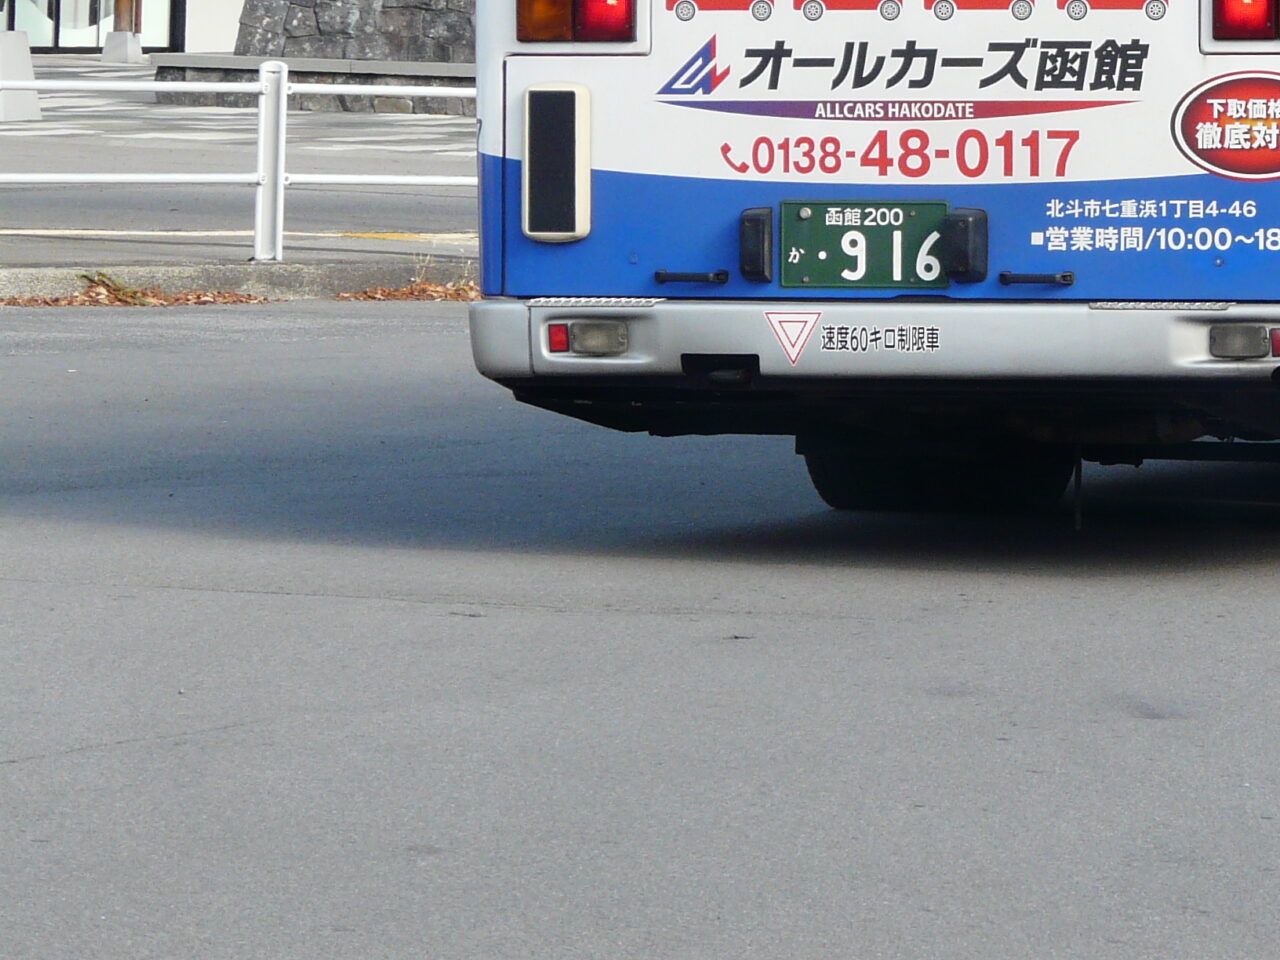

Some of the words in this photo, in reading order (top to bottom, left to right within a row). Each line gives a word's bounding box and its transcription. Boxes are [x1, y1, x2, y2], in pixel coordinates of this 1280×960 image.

[738, 38, 1150, 91] オールカーズ函館
[815, 102, 884, 118] ALLCARS
[888, 102, 974, 119] HAKODATE
[751, 128, 1081, 178] 0138-48-0117
[1045, 199, 1257, 219] 北斗市七重浜1丁目4-46
[821, 326, 940, 352] 速度60キロ制限車
